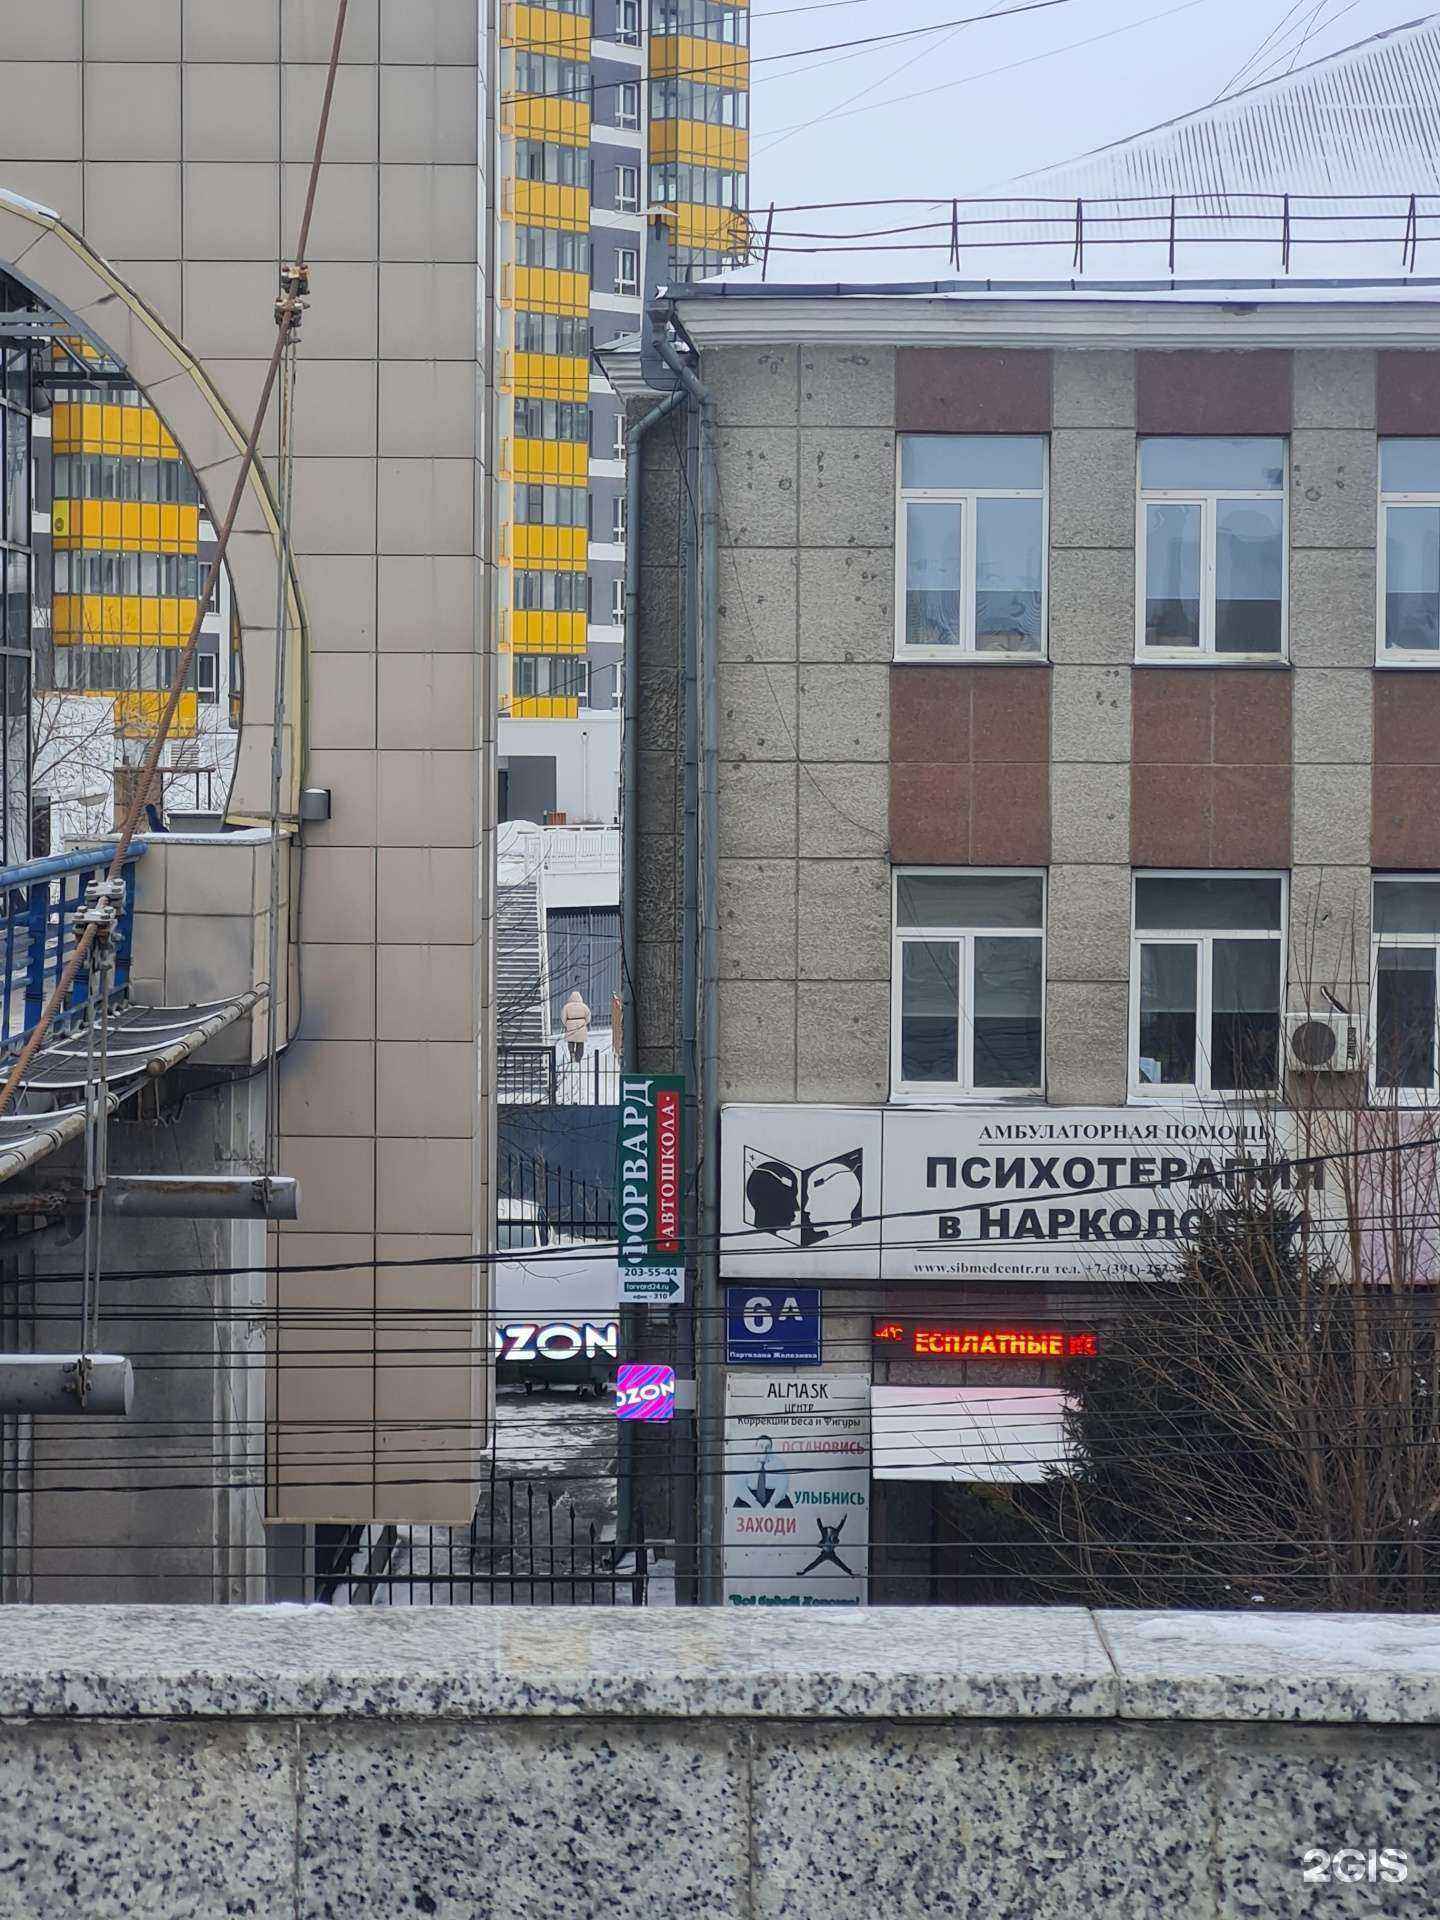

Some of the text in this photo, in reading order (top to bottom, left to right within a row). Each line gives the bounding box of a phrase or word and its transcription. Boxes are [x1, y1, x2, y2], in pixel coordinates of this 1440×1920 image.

[979, 1124, 1158, 1139] АМБУЛАТОРНАЯ
[622, 1080, 654, 1263] ФОРВАРД
[661, 1103, 675, 1238] АВТОШКОЛА
[926, 1156, 1324, 1190] ПСИХОТЕРАПИЯ
[624, 1267, 678, 1277] 203-55-44
[914, 1262, 1049, 1275] www.sibmedcentr.ru
[1055, 1264, 1080, 1275] тел.
[495, 1325, 618, 1360] ZON
[767, 1383, 829, 1399] ALMASK
[784, 1403, 814, 1413] ЦЕНТР
[781, 1440, 865, 1455] ОСТАНОВИСЬ
[794, 1491, 865, 1505] УЛЫБНИСЬ
[736, 1516, 797, 1536] ЗАХОДИ
